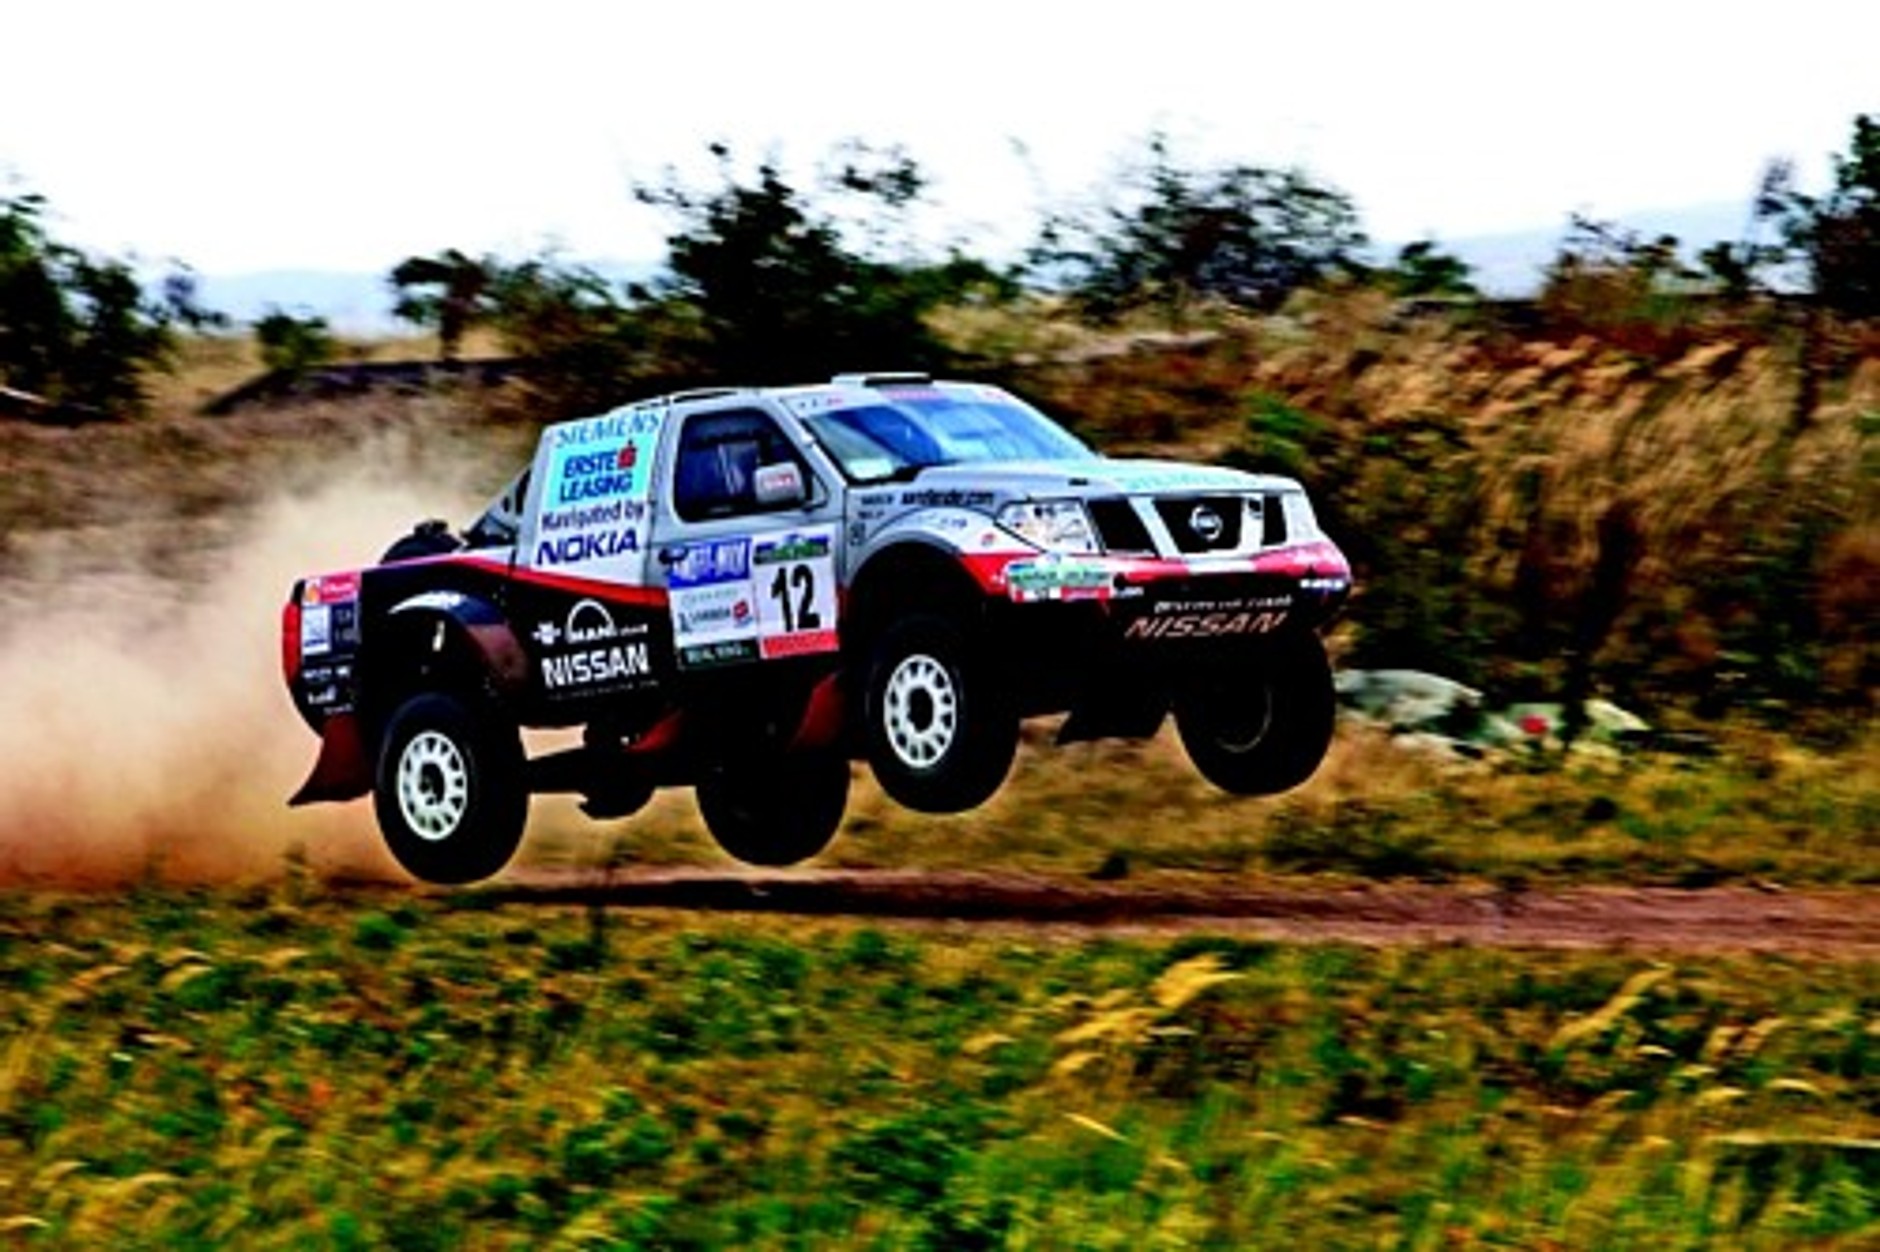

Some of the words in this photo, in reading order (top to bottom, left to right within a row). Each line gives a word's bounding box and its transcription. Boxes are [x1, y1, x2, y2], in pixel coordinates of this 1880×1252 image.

[555, 412, 659, 447] SIEMENS
[564, 450, 618, 479] ERSTE
[559, 472, 634, 502] LEASING
[541, 501, 622, 532] Navigated
[624, 500, 645, 521] by
[536, 528, 639, 566] NOKIA
[770, 563, 822, 633] 12
[1123, 610, 1288, 639] NISSAN
[541, 641, 650, 689] NISSAN
